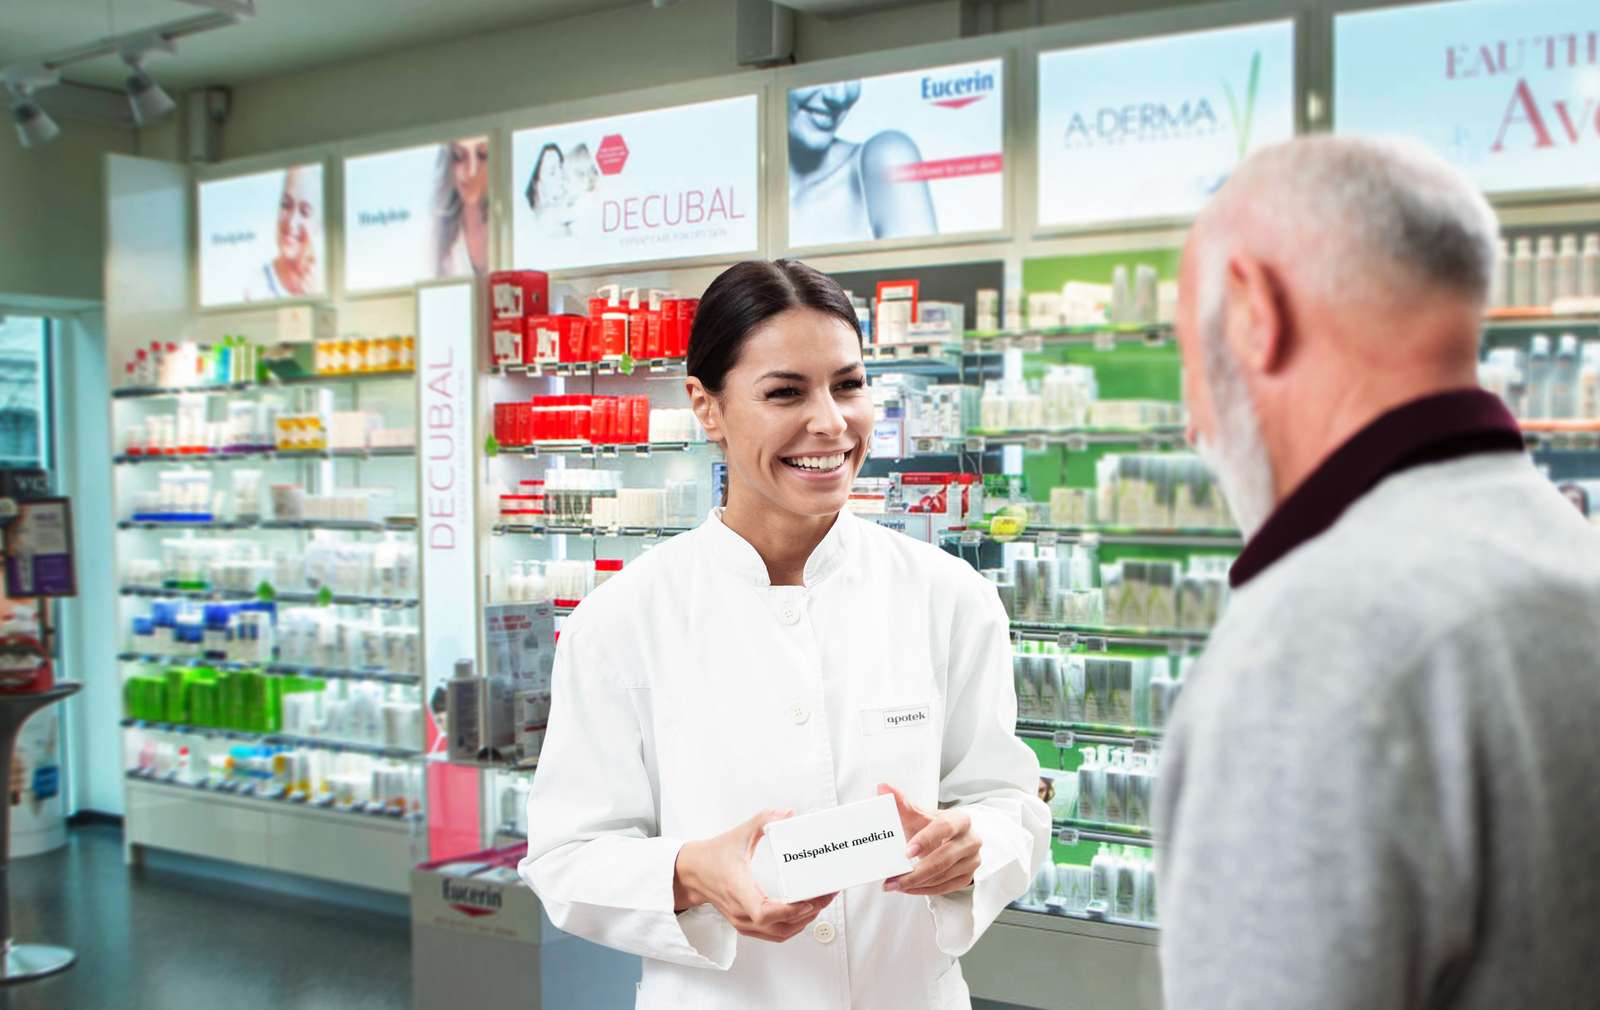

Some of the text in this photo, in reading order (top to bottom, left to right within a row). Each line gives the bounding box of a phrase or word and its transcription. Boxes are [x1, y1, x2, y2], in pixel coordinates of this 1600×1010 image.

[1446, 39, 1526, 80] EAU
[921, 70, 993, 99] Eucerin
[1064, 97, 1217, 140] A-DERMA
[1490, 77, 1600, 152] Av
[602, 184, 745, 233] DECUBAL
[428, 346, 454, 550] DECUBAL
[887, 711, 926, 725] apotek
[783, 829, 895, 863] Dosispakket medicin
[442, 878, 503, 909] Eucerin
